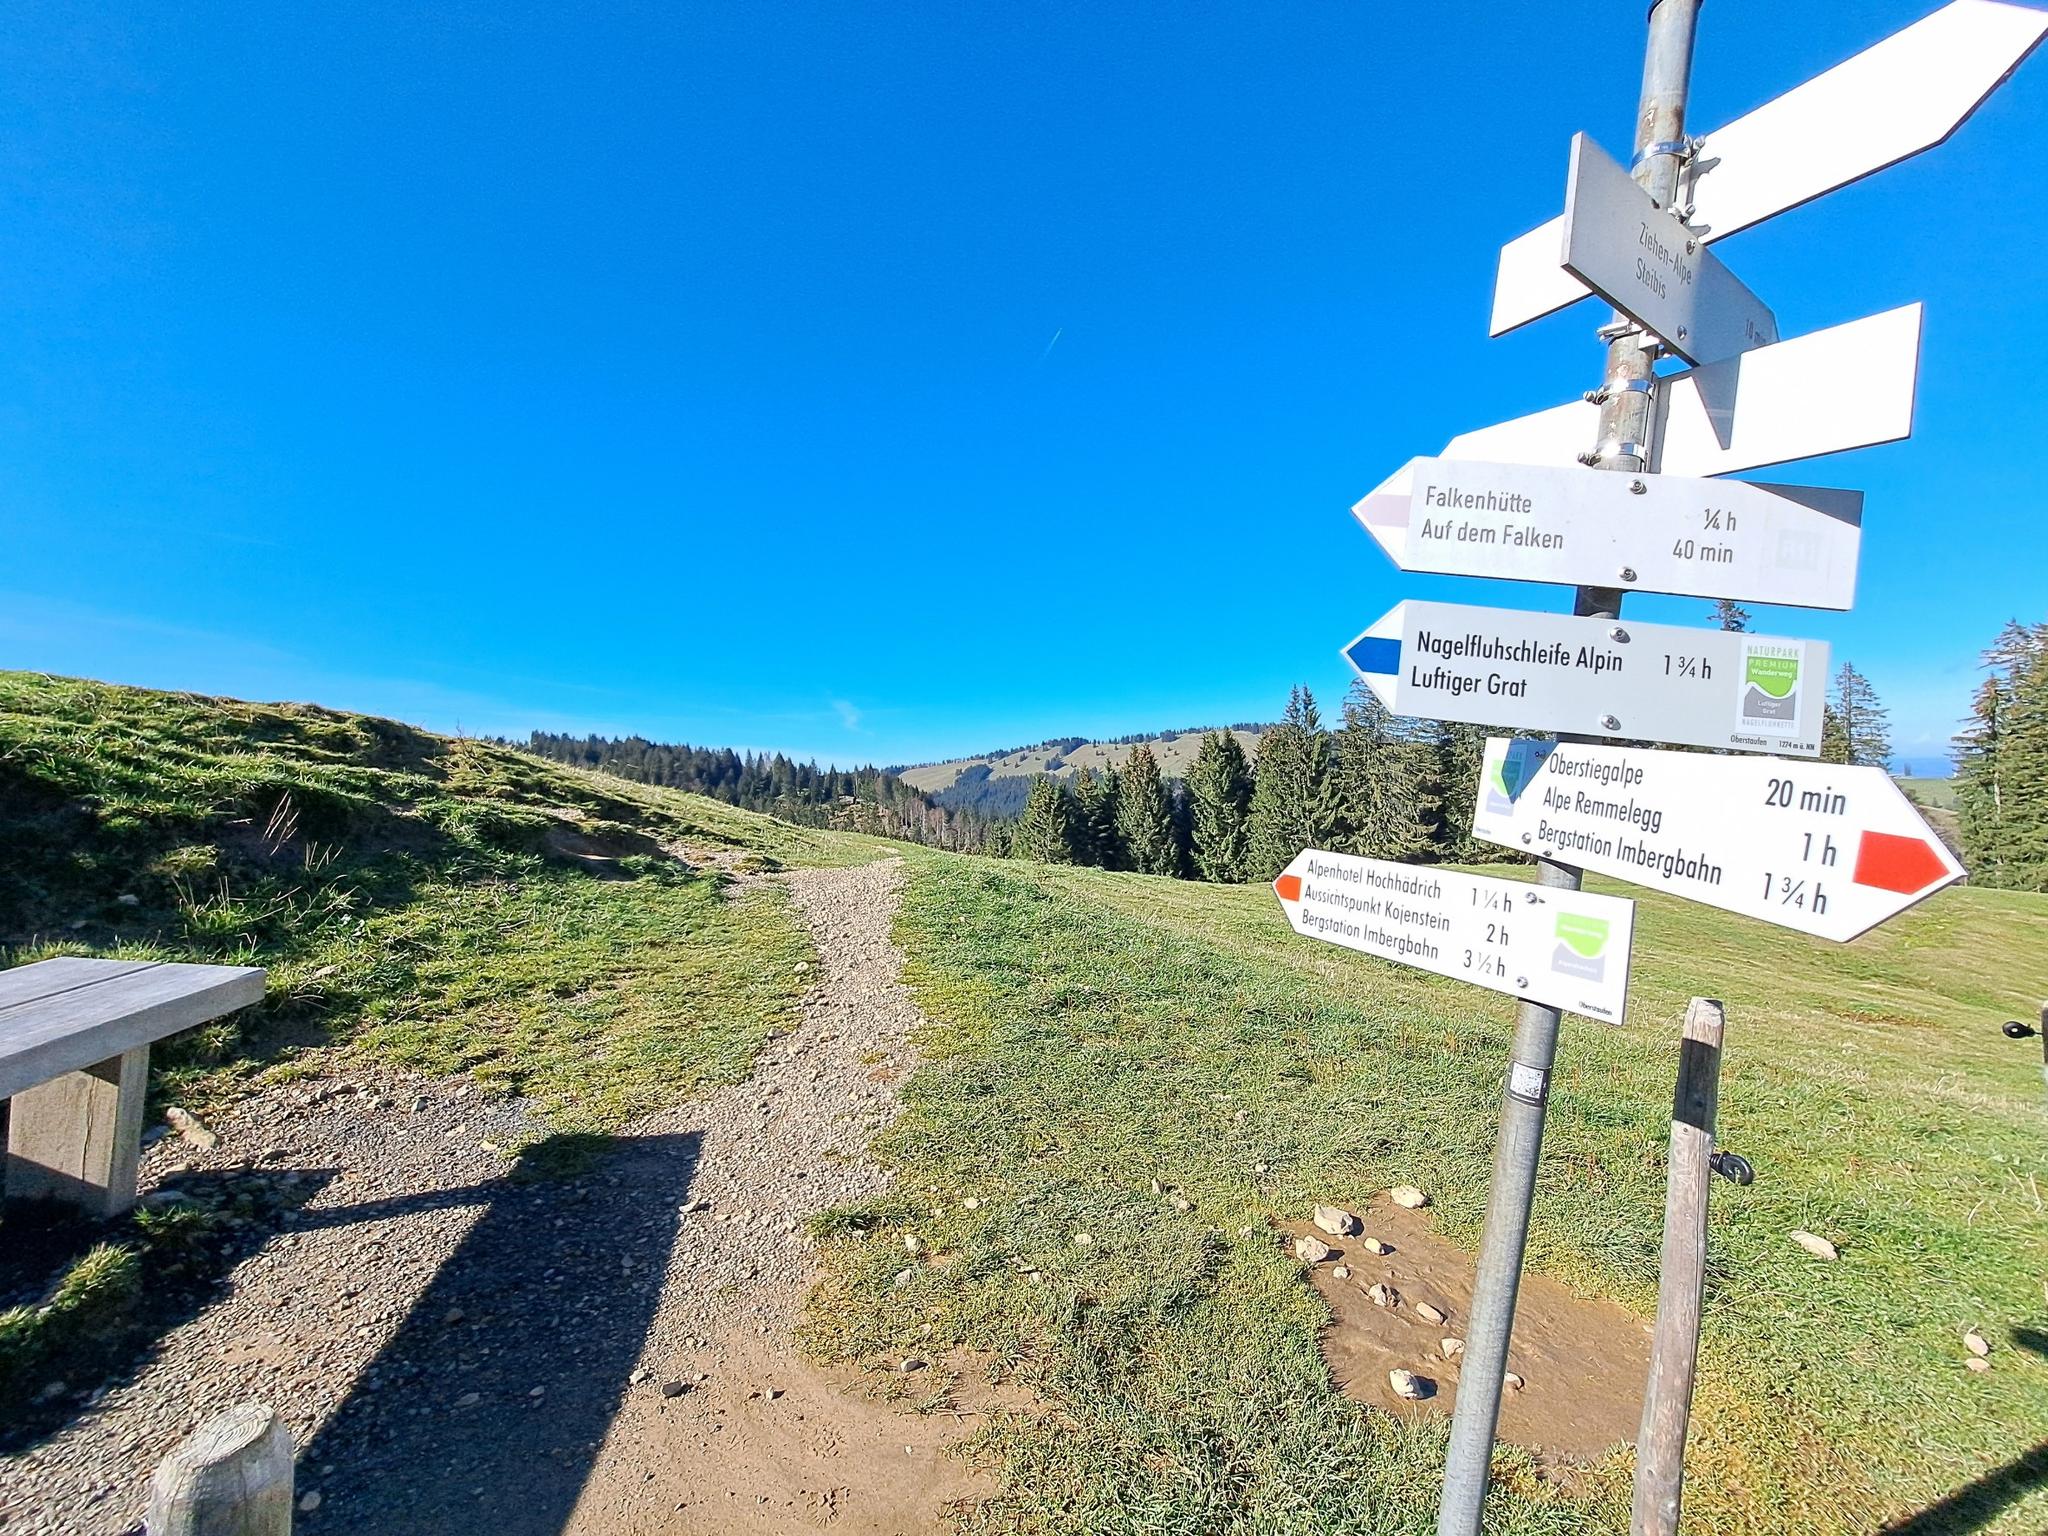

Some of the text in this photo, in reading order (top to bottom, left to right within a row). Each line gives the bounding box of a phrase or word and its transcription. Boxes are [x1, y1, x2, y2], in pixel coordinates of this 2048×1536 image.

[1639, 222, 1692, 286] Ziehen-Alpe
[1636, 258, 1667, 300] Steibis
[1426, 485, 1532, 514] Falkenhütte
[1421, 518, 1564, 550] Auf dem Falken
[1726, 511, 1737, 531] h
[1672, 539, 1734, 564] 40 min
[1417, 630, 1623, 675] Nagelfluhschleife Alpin
[1747, 645, 1799, 659] NATURPARK
[1748, 658, 1797, 669] PREMIUM
[1411, 665, 1528, 698] Luftiger Grat
[1702, 657, 1712, 680] h
[1751, 669, 1793, 679] Wanderweg
[1730, 734, 1767, 746] Oberstaufen
[1779, 740, 1792, 749] 1274
[1549, 752, 1644, 789] Oberstiegalpe
[1543, 786, 1663, 834] Alpe Remmelegg
[1765, 778, 1846, 815] 20 min
[1538, 819, 1722, 886] Bergstation Imbergbahn
[1804, 832, 1837, 867] 1 h
[1307, 859, 1442, 900] Alpenhotel Hochhädrich
[1305, 884, 1451, 932] Aussichtspunkt Kojenstein
[1503, 892, 1512, 913] h
[1812, 882, 1827, 915] h
[1302, 908, 1439, 960] Bergstation Imbergbahn
[1486, 923, 1509, 946] 2 h
[1496, 956, 1505, 977] h
